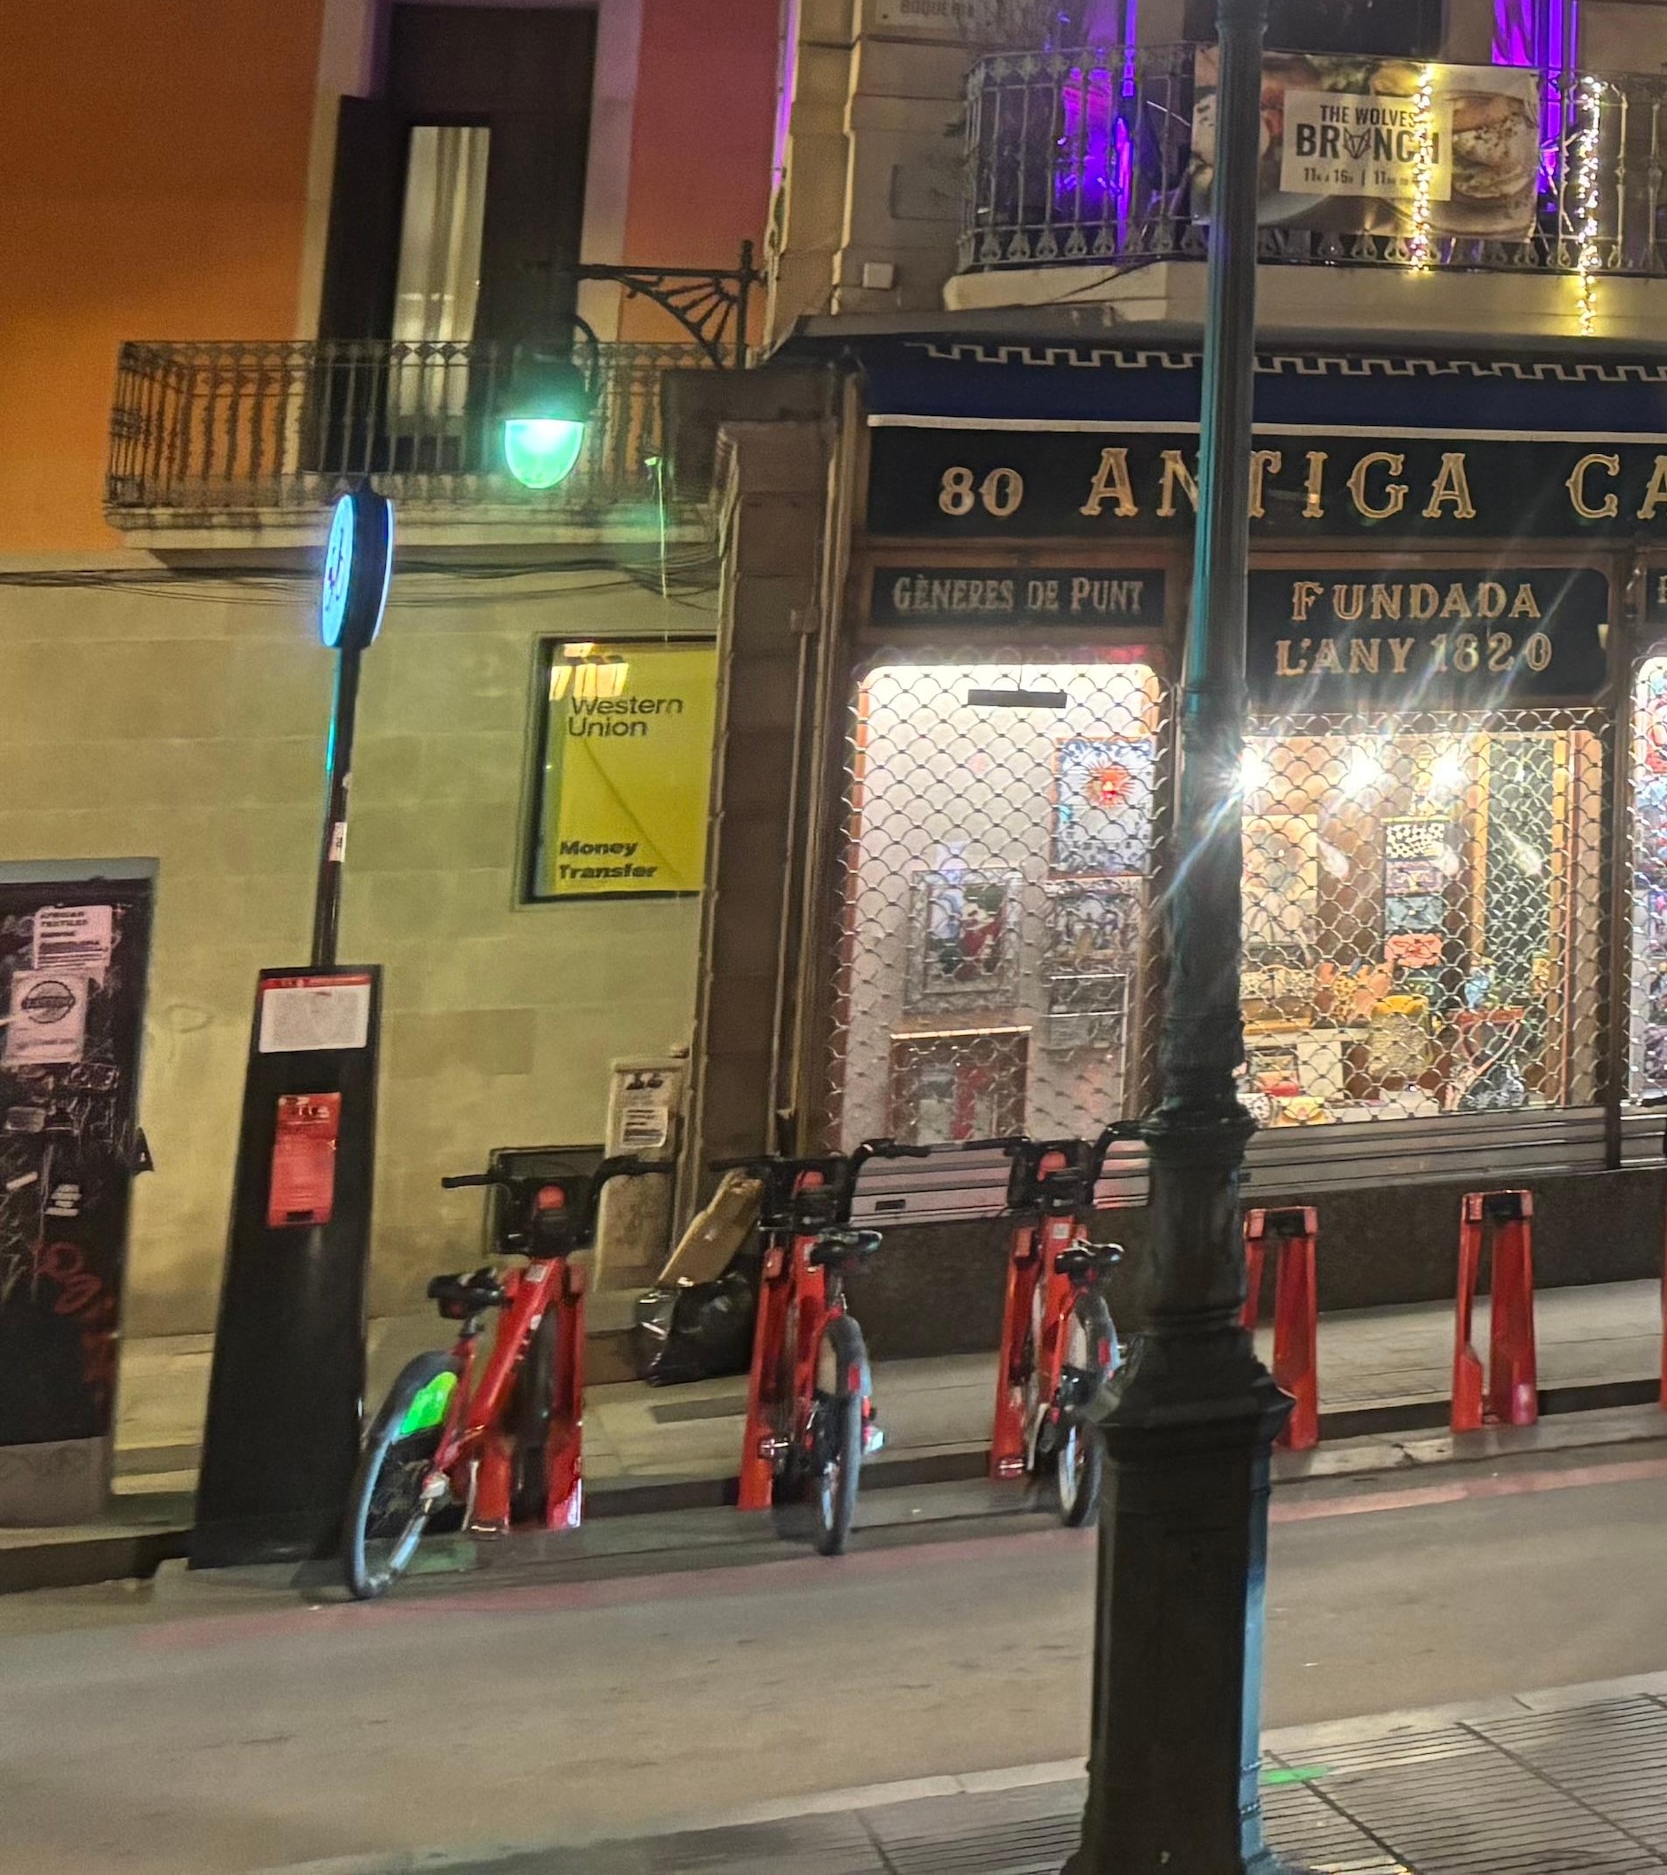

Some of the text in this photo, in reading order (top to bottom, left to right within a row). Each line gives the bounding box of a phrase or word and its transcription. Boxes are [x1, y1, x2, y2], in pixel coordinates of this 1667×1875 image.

[1320, 105, 1416, 127] THE WOLVES
[938, 466, 1023, 516] 80
[1079, 447, 1477, 518] ANTIGA
[893, 574, 1144, 612] GÈNERES DE PUNT
[1291, 581, 1541, 621] FUNDADA
[1275, 632, 1552, 676] L'ANY 1820
[571, 695, 684, 715] Western
[568, 717, 648, 737] Union
[560, 841, 638, 857] Money
[559, 863, 658, 879] Transfer
